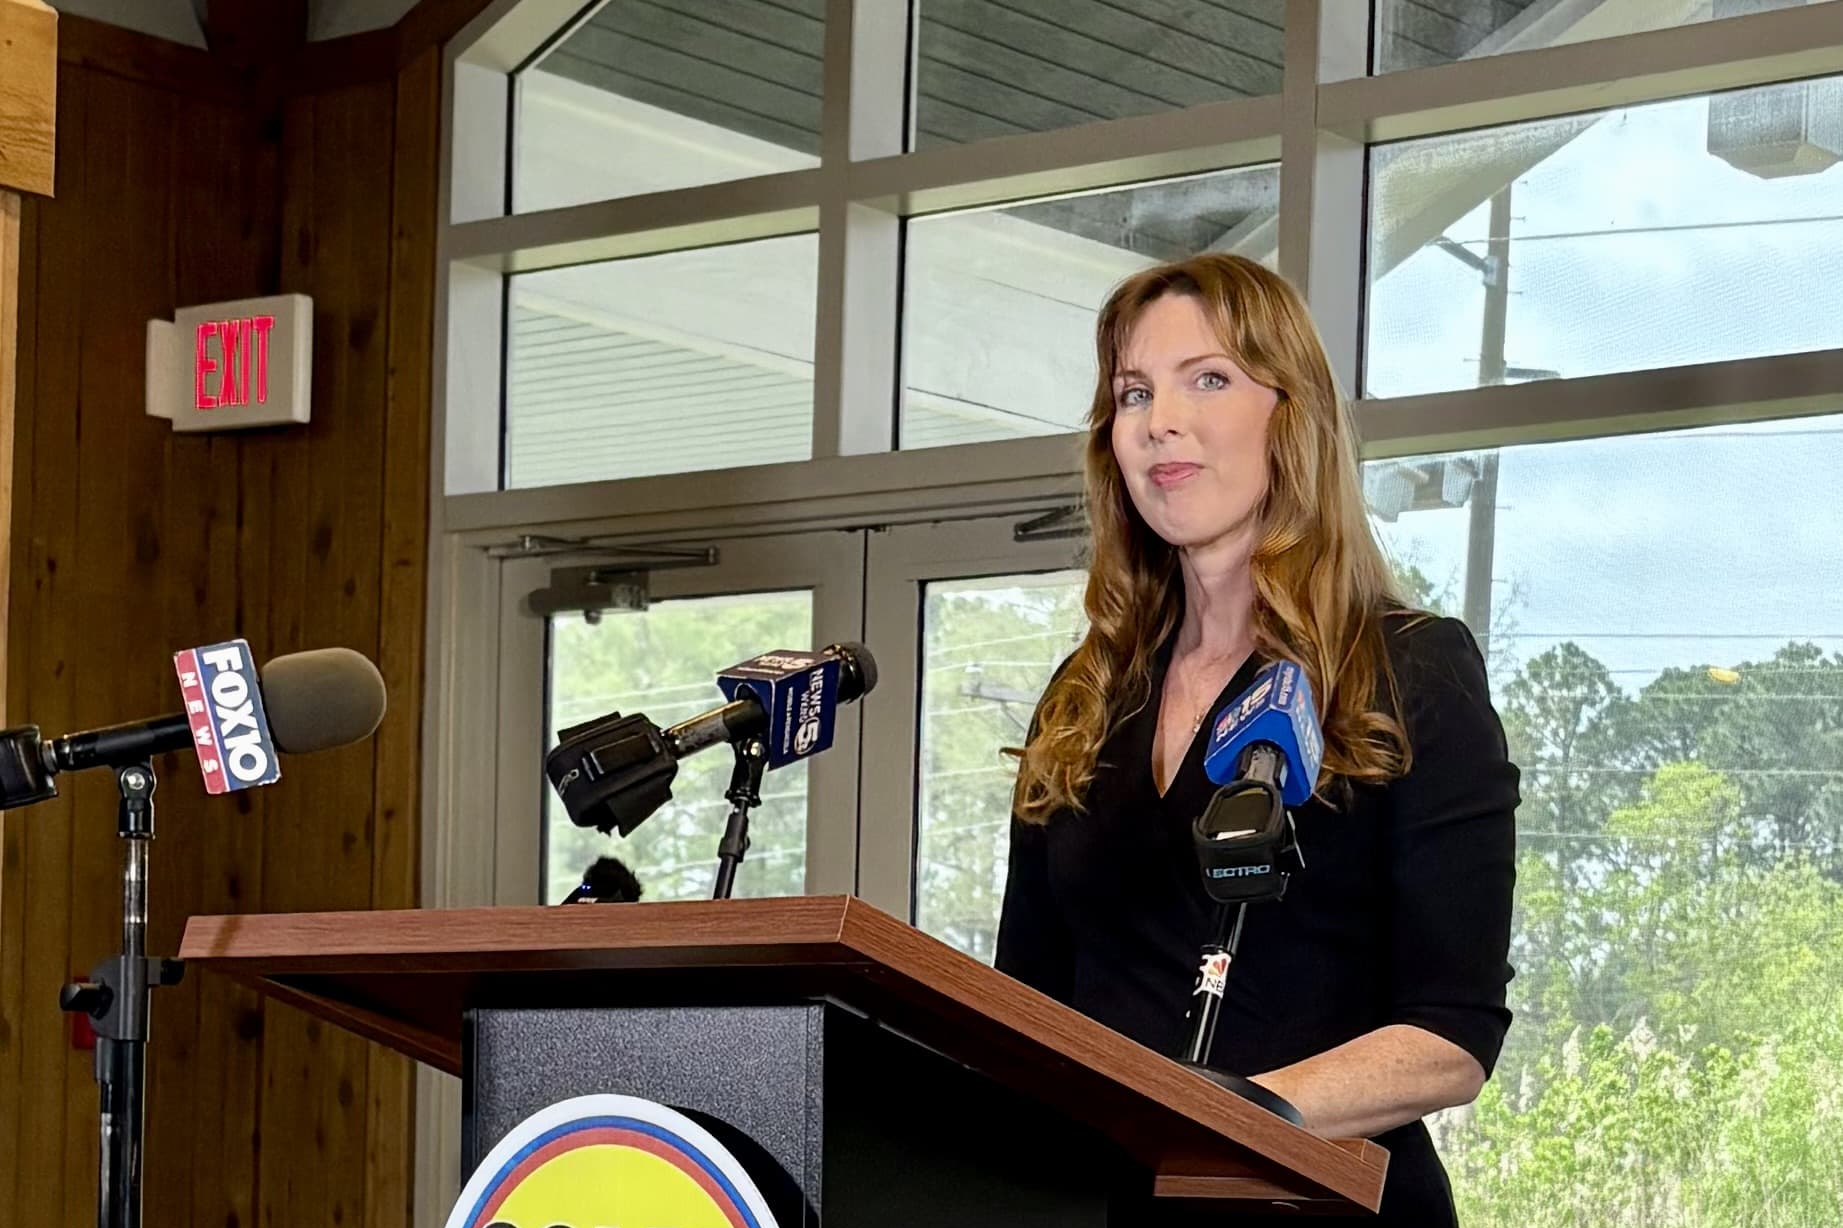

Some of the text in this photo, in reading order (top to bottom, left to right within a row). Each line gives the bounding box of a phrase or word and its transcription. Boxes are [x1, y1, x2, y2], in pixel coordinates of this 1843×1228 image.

[195, 316, 275, 410] EXIT
[181, 671, 219, 774] NEWS
[795, 667, 824, 752] NEWS 5
